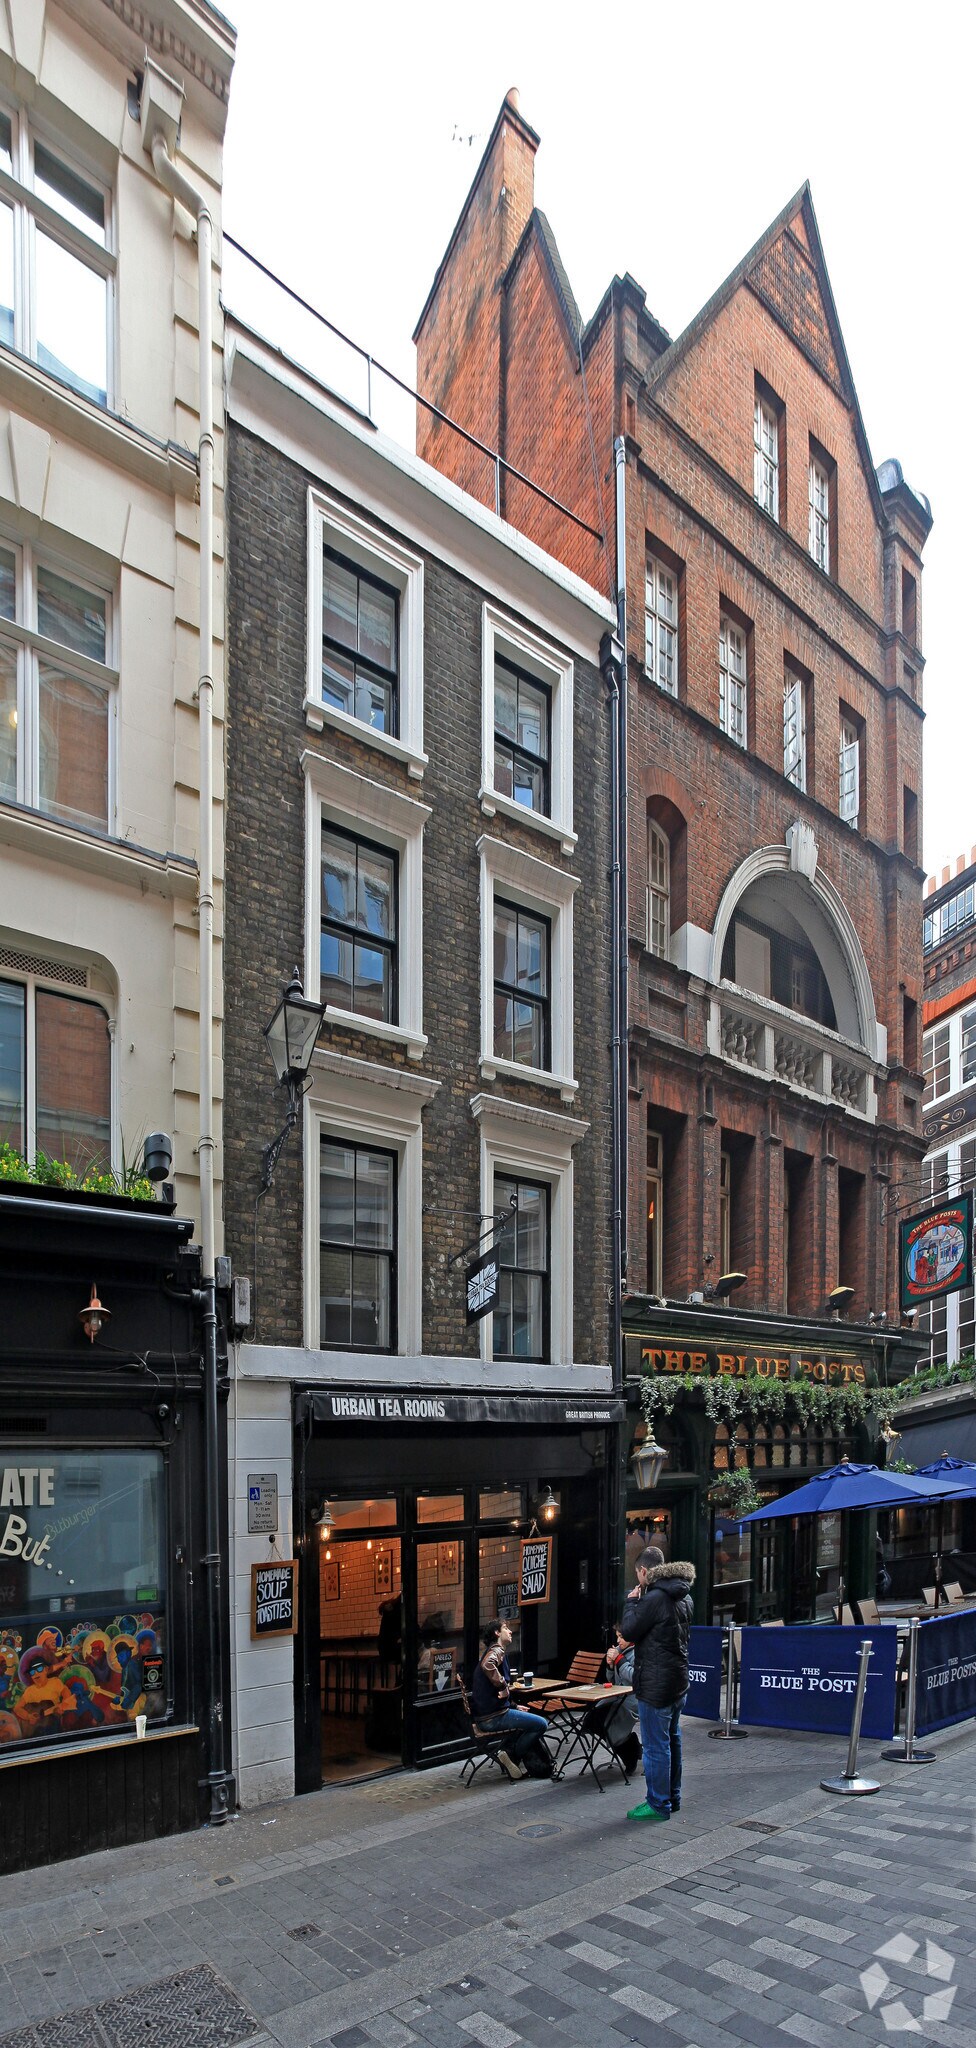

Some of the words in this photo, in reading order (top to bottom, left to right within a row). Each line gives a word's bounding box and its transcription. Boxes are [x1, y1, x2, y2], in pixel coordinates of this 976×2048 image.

[912, 1222, 923, 1234] THE
[924, 1214, 939, 1226] BLUE
[940, 1210, 957, 1218] POSTS
[641, 1348, 707, 1373] THE
[716, 1353, 790, 1378] BLUE
[797, 1360, 865, 1383] POSTS
[331, 1397, 375, 1417] URBAN
[377, 1399, 402, 1417] TEA
[404, 1400, 446, 1418] ROOMS
[565, 1410, 579, 1419] GREAT
[578, 1411, 593, 1419] BRITISH
[593, 1411, 611, 1419] PRODUCE
[0, 1468, 54, 1506] ATE
[43, 1504, 98, 1542] Bitburger
[523, 1543, 548, 1557] HOMEMADE
[522, 1553, 547, 1573] QUICHE
[256, 1567, 292, 1584] HOMEMADE
[521, 1572, 546, 1596] SALAD
[256, 1581, 288, 1603] SOUP
[256, 1601, 292, 1625] TOASTIES
[434, 1652, 452, 1662] TABLES
[947, 1657, 959, 1667] THE
[802, 1667, 820, 1676] THE
[927, 1670, 949, 1690] BLUE
[950, 1661, 976, 1682] POSTS
[760, 1675, 803, 1690] BLUE
